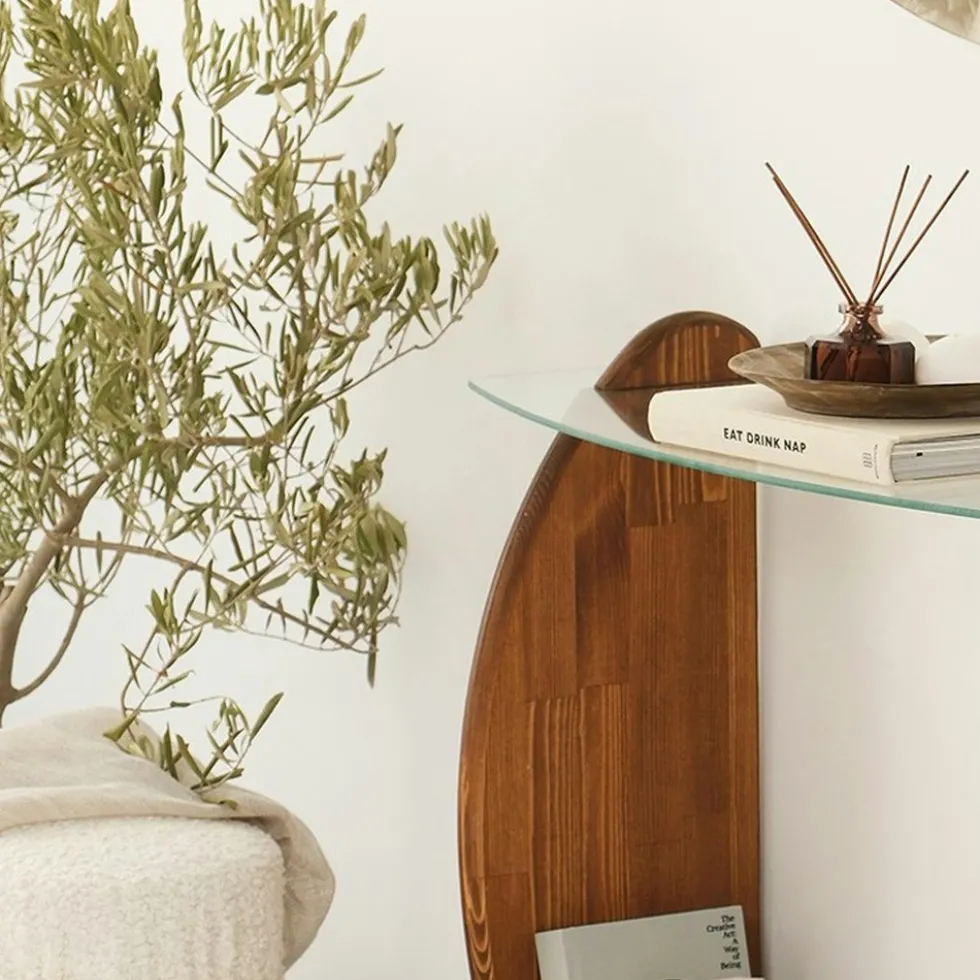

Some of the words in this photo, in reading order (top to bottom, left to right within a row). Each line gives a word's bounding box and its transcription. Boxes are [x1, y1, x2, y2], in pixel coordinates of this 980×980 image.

[723, 427, 744, 442] EAT
[746, 431, 781, 450] DRINK
[783, 438, 807, 454] NAP
